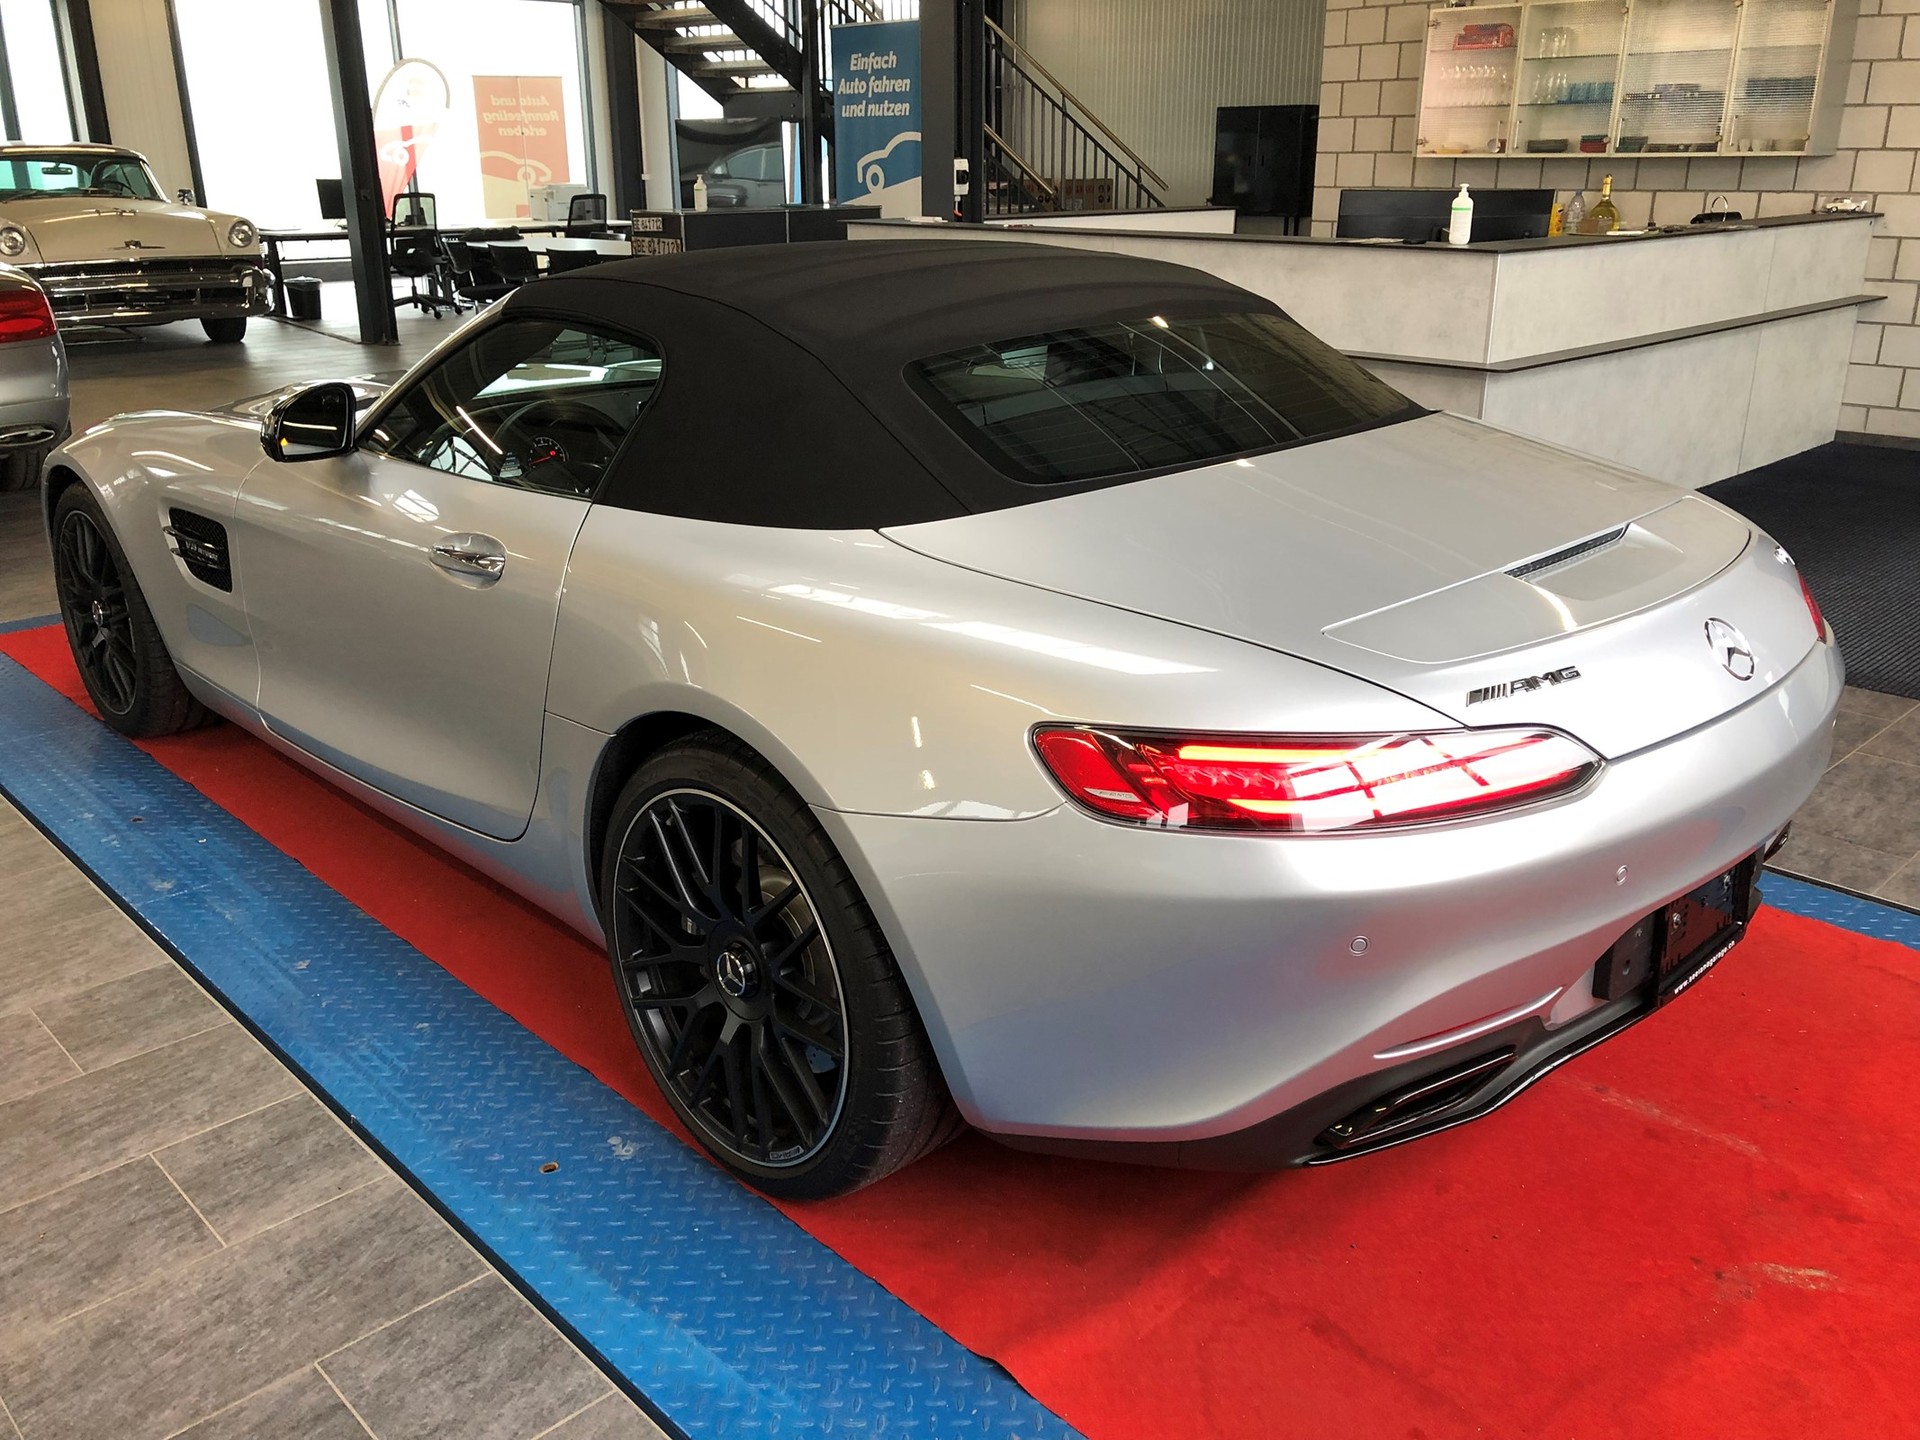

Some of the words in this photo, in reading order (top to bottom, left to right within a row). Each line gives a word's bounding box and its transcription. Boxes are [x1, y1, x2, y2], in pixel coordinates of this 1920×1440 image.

[850, 51, 897, 74] Einfach
[838, 77, 867, 95] Auto
[868, 75, 911, 98] fahren
[841, 100, 866, 117] und
[867, 100, 910, 117] nutzen
